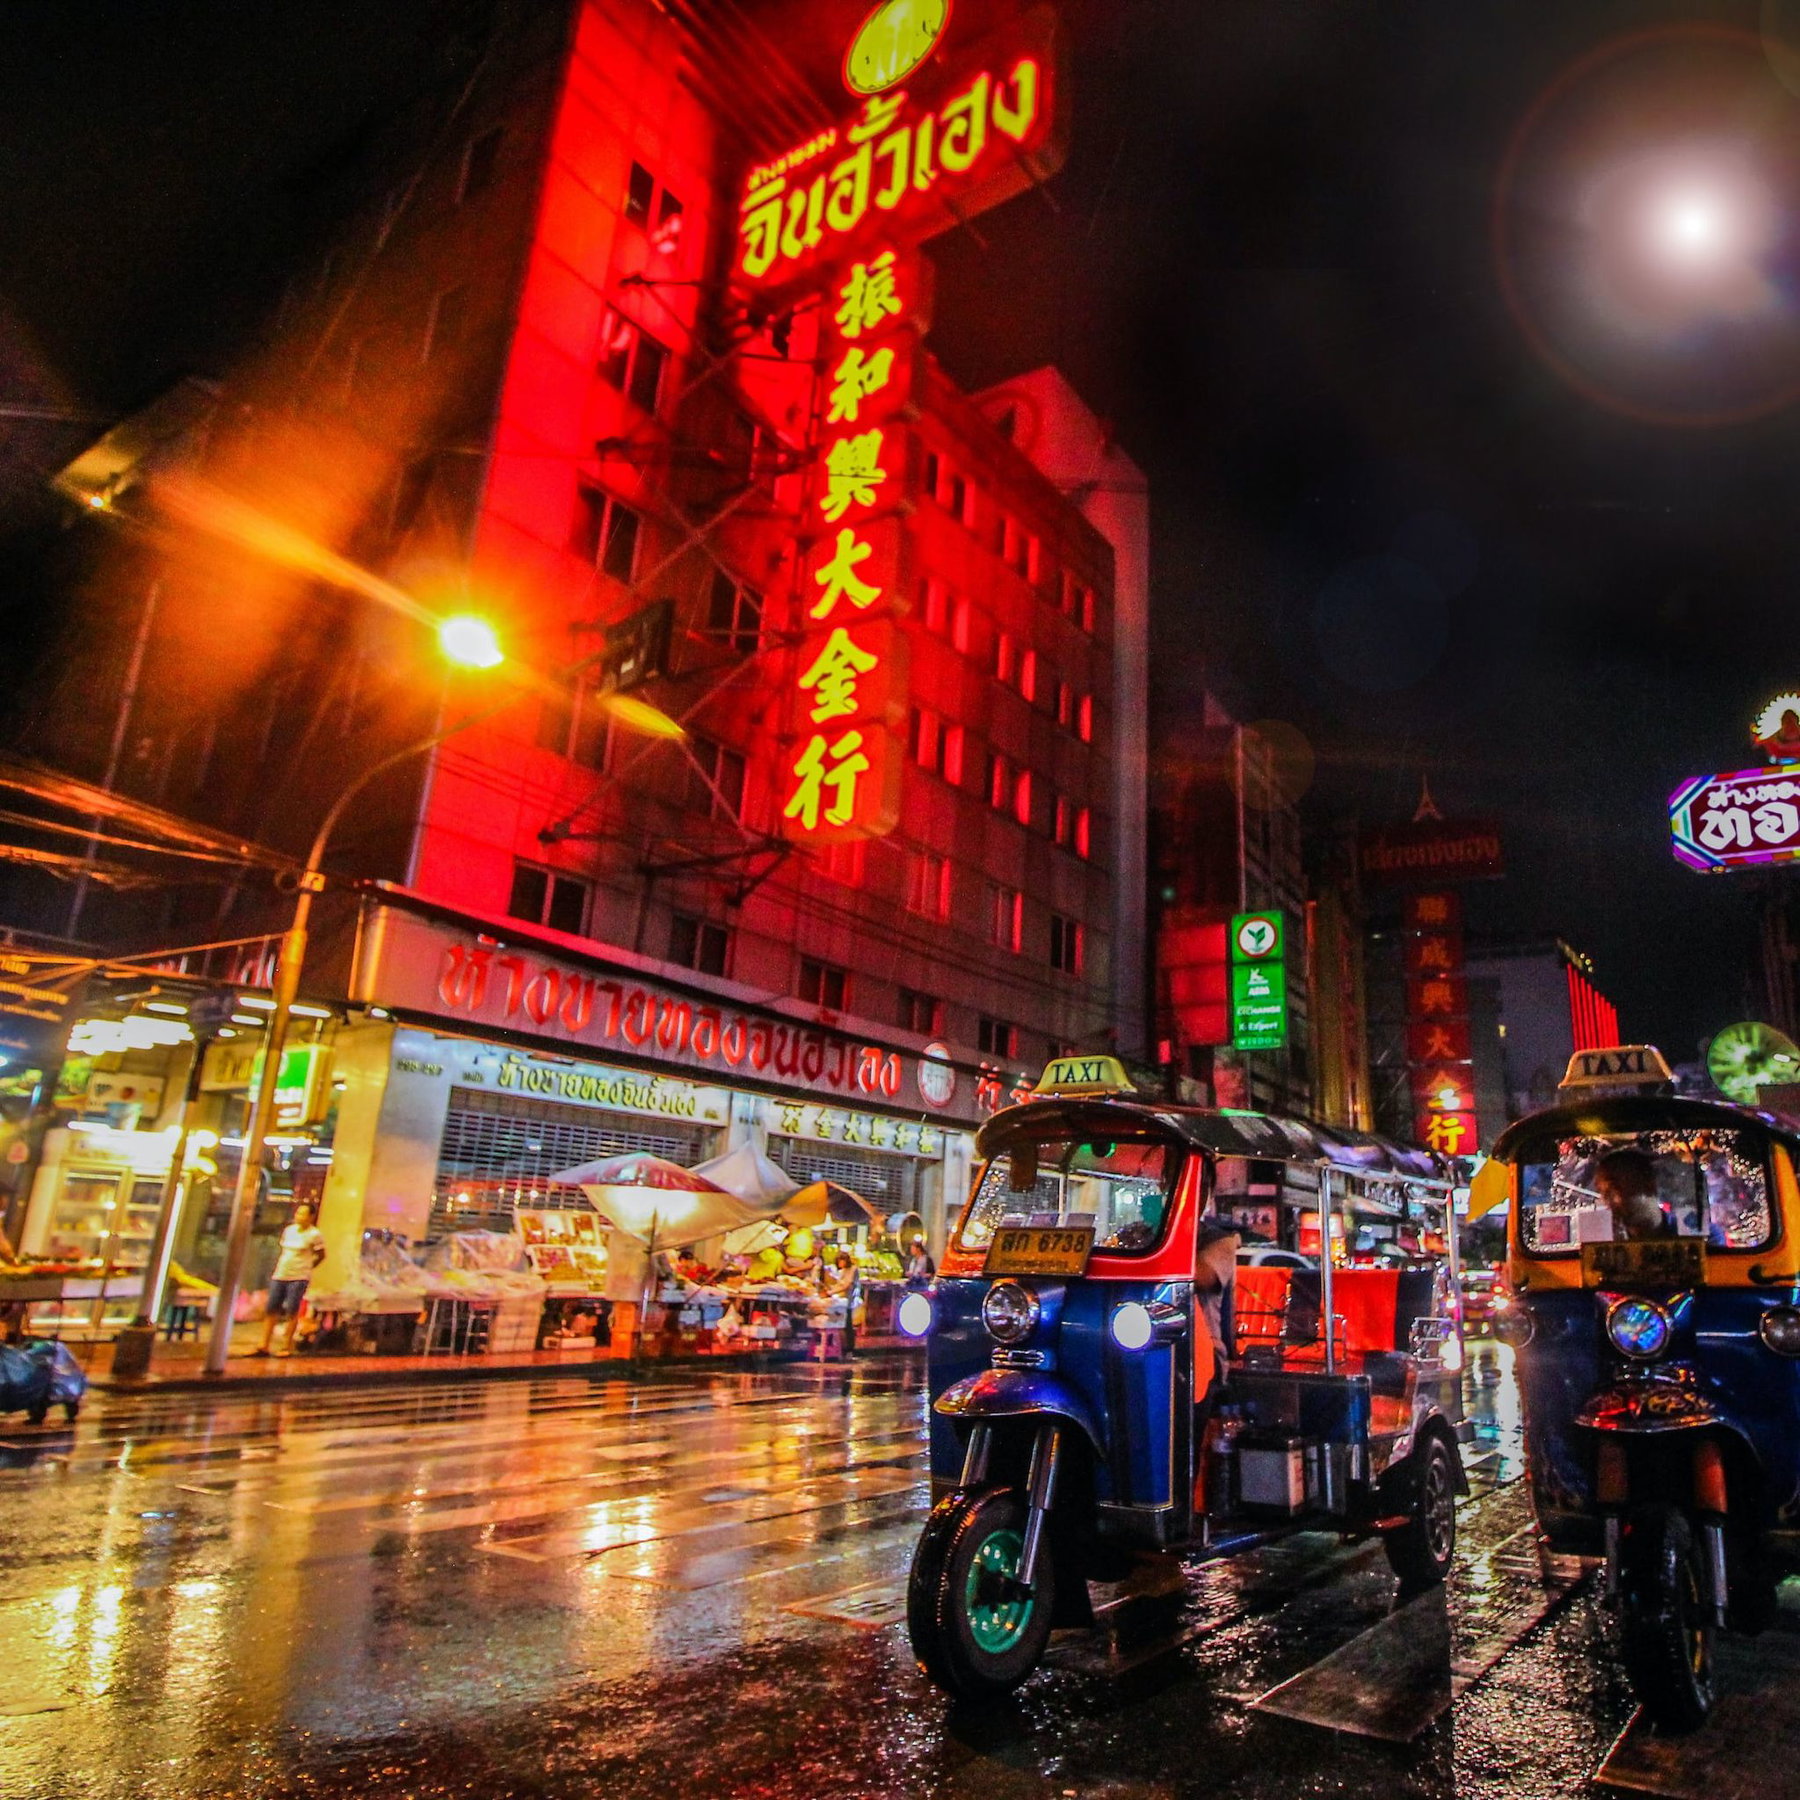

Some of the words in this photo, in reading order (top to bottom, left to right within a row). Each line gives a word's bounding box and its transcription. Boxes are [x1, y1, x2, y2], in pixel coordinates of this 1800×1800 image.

[784, 250, 902, 831] 振和興大金行
[1052, 1061, 1104, 1084] TAXI
[1579, 1052, 1645, 1076] TAXI
[1038, 1233, 1085, 1252] 6738
